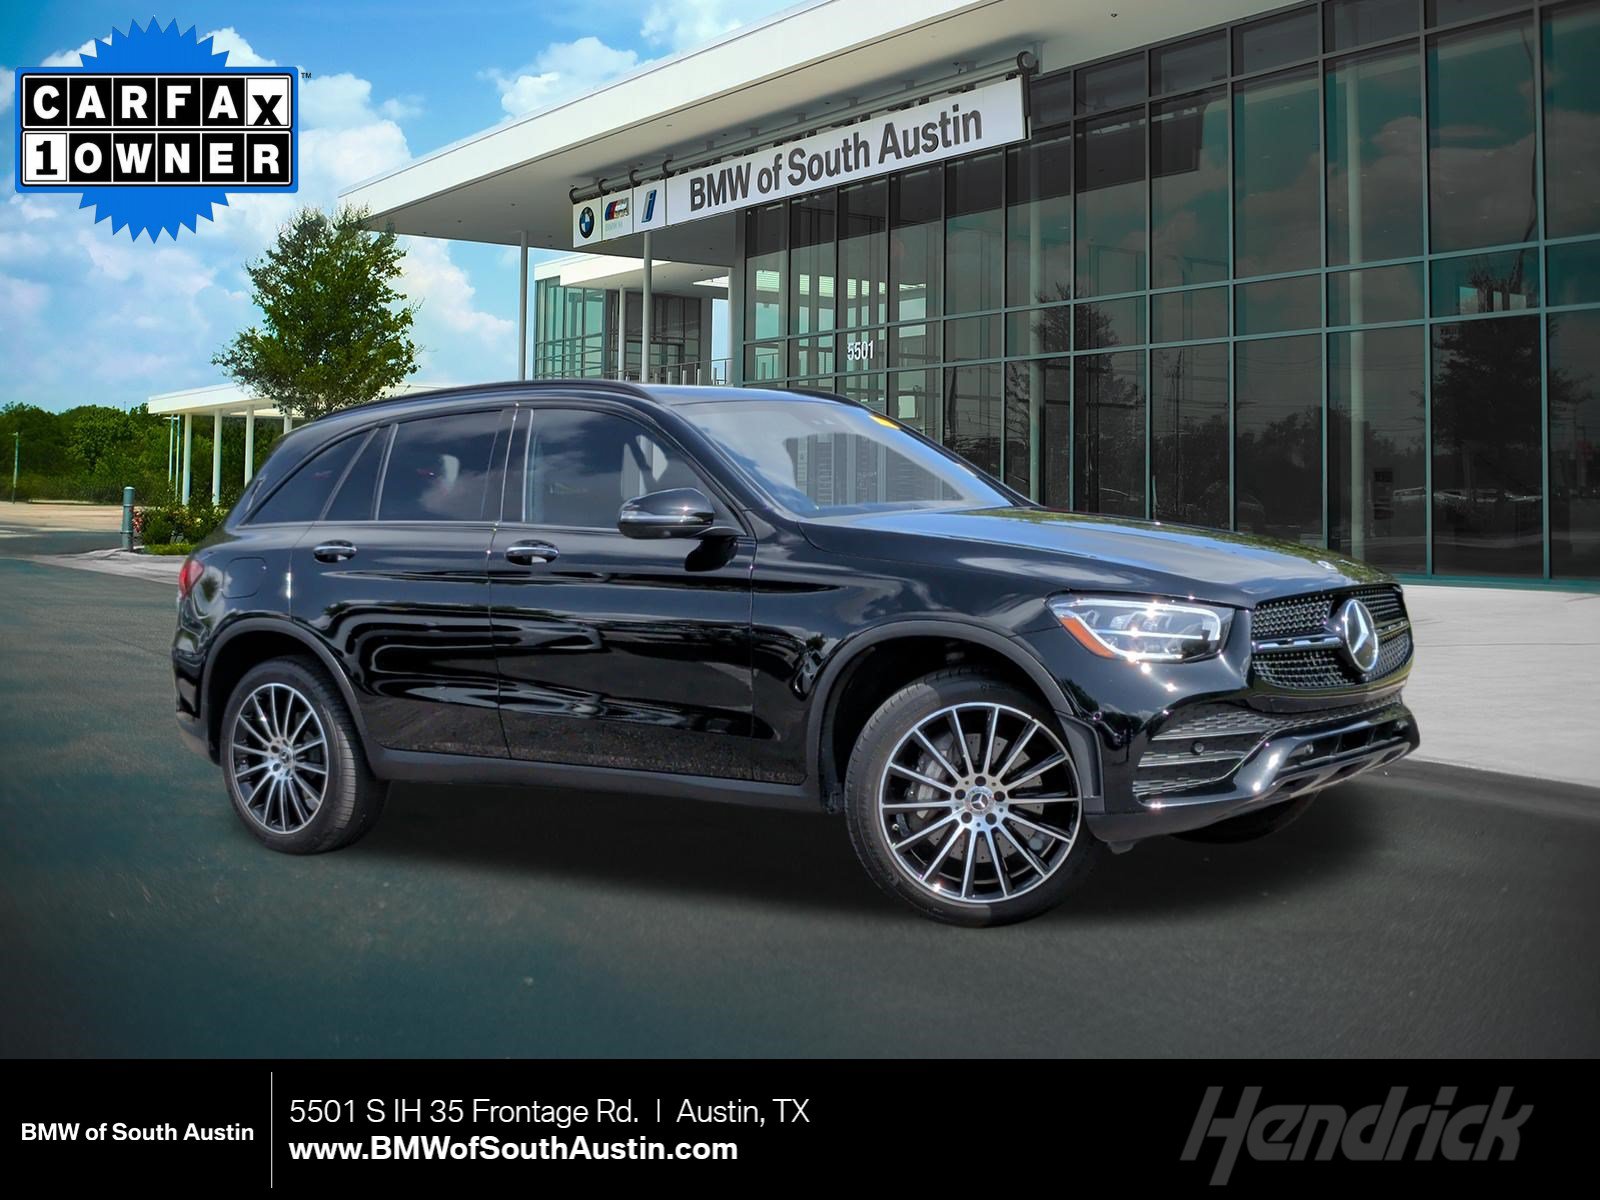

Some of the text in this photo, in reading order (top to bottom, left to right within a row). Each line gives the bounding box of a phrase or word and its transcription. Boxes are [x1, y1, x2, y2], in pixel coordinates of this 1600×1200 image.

[689, 103, 983, 212] BMW of South Austin
[847, 339, 874, 360] 5501
